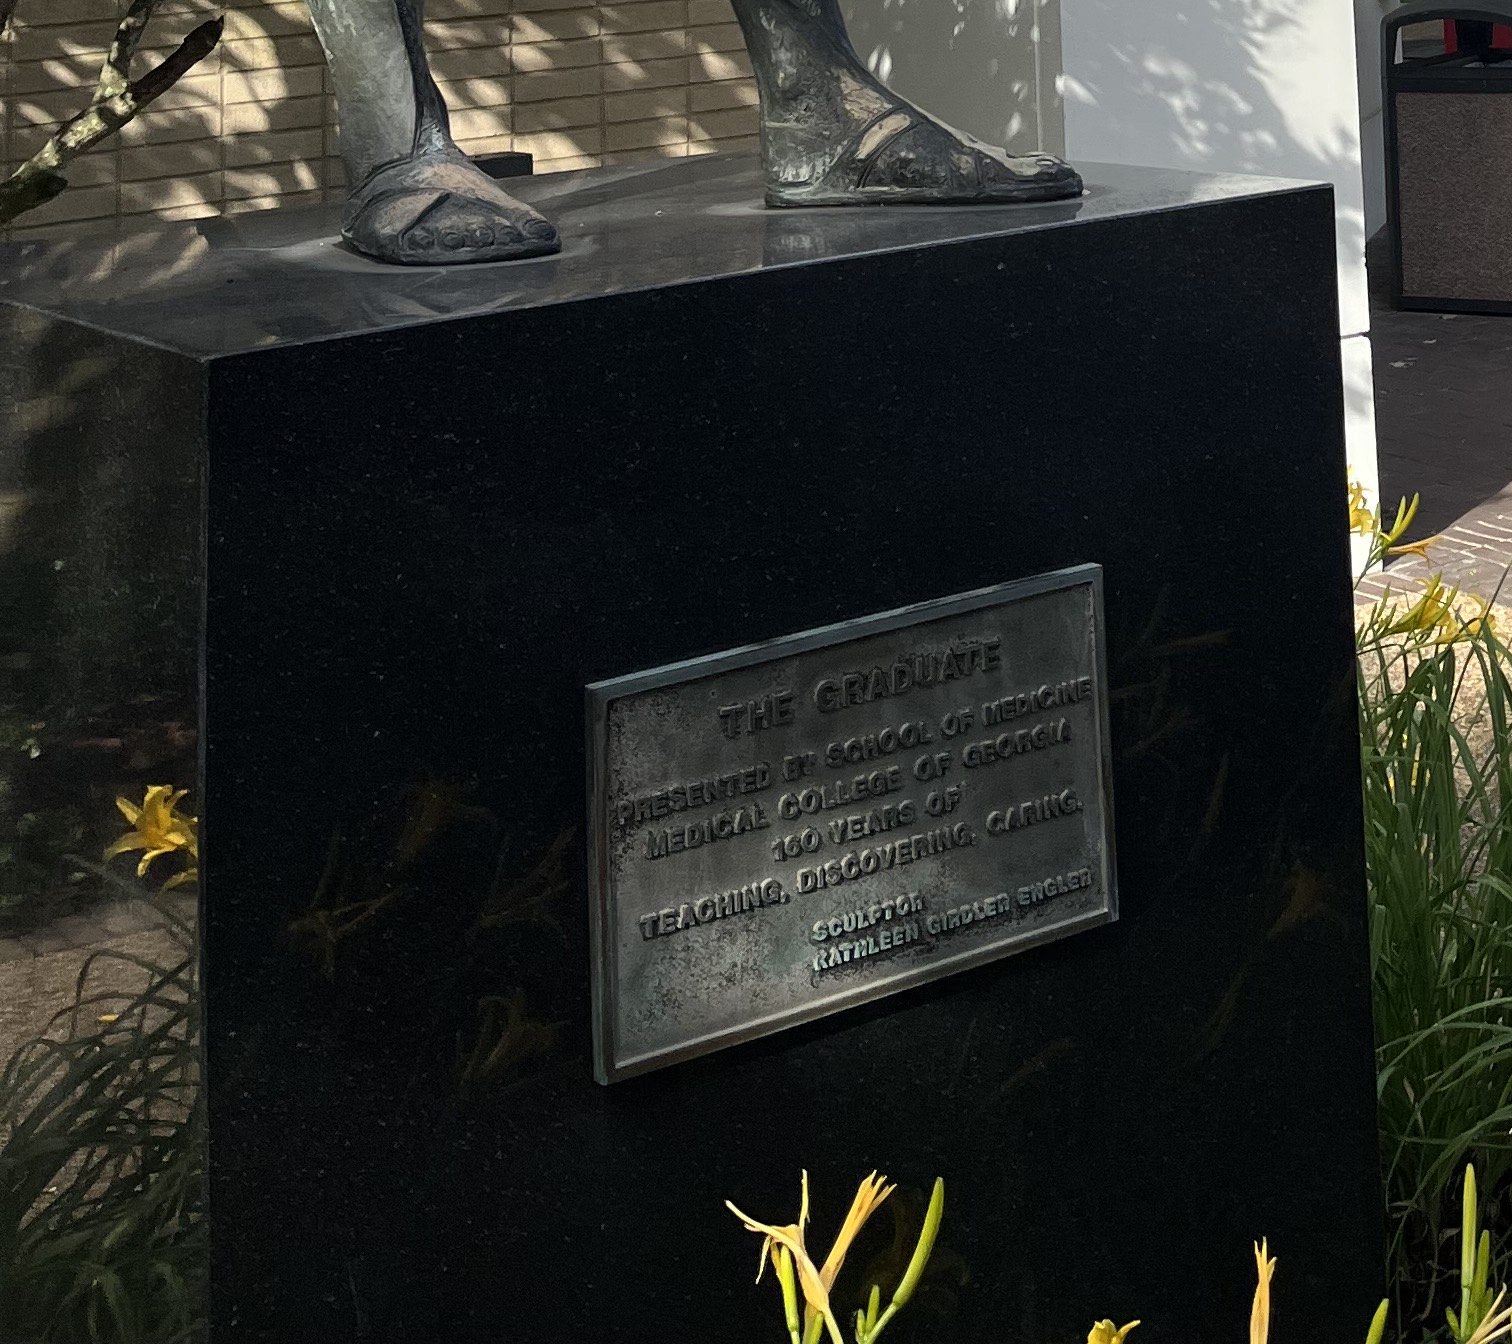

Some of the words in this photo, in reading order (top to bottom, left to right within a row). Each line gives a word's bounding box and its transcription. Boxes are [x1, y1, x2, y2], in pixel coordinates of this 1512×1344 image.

[717, 686, 795, 740] THE
[813, 636, 1000, 713] GRADUATE
[614, 762, 772, 826] PRESENTED
[782, 752, 818, 781] BY
[825, 720, 933, 768] SCHOOL
[940, 708, 975, 740] OF
[980, 675, 1093, 726] MEDICINE
[646, 801, 771, 860] MEDICAL
[777, 765, 902, 820] COLLEGE
[913, 752, 951, 781] OF
[962, 717, 1073, 768] GEORGIA
[638, 877, 791, 941] TEACHING,
[985, 788, 1084, 836] CARING.
[771, 824, 821, 861] 160
[828, 799, 916, 844] YEARS
[926, 786, 962, 816] OF
[810, 891, 926, 943] SCULPTOR
[812, 920, 920, 972] KATHLEEN
[926, 892, 1011, 935] GIRDLER
[1017, 867, 1093, 907] ENGLER
